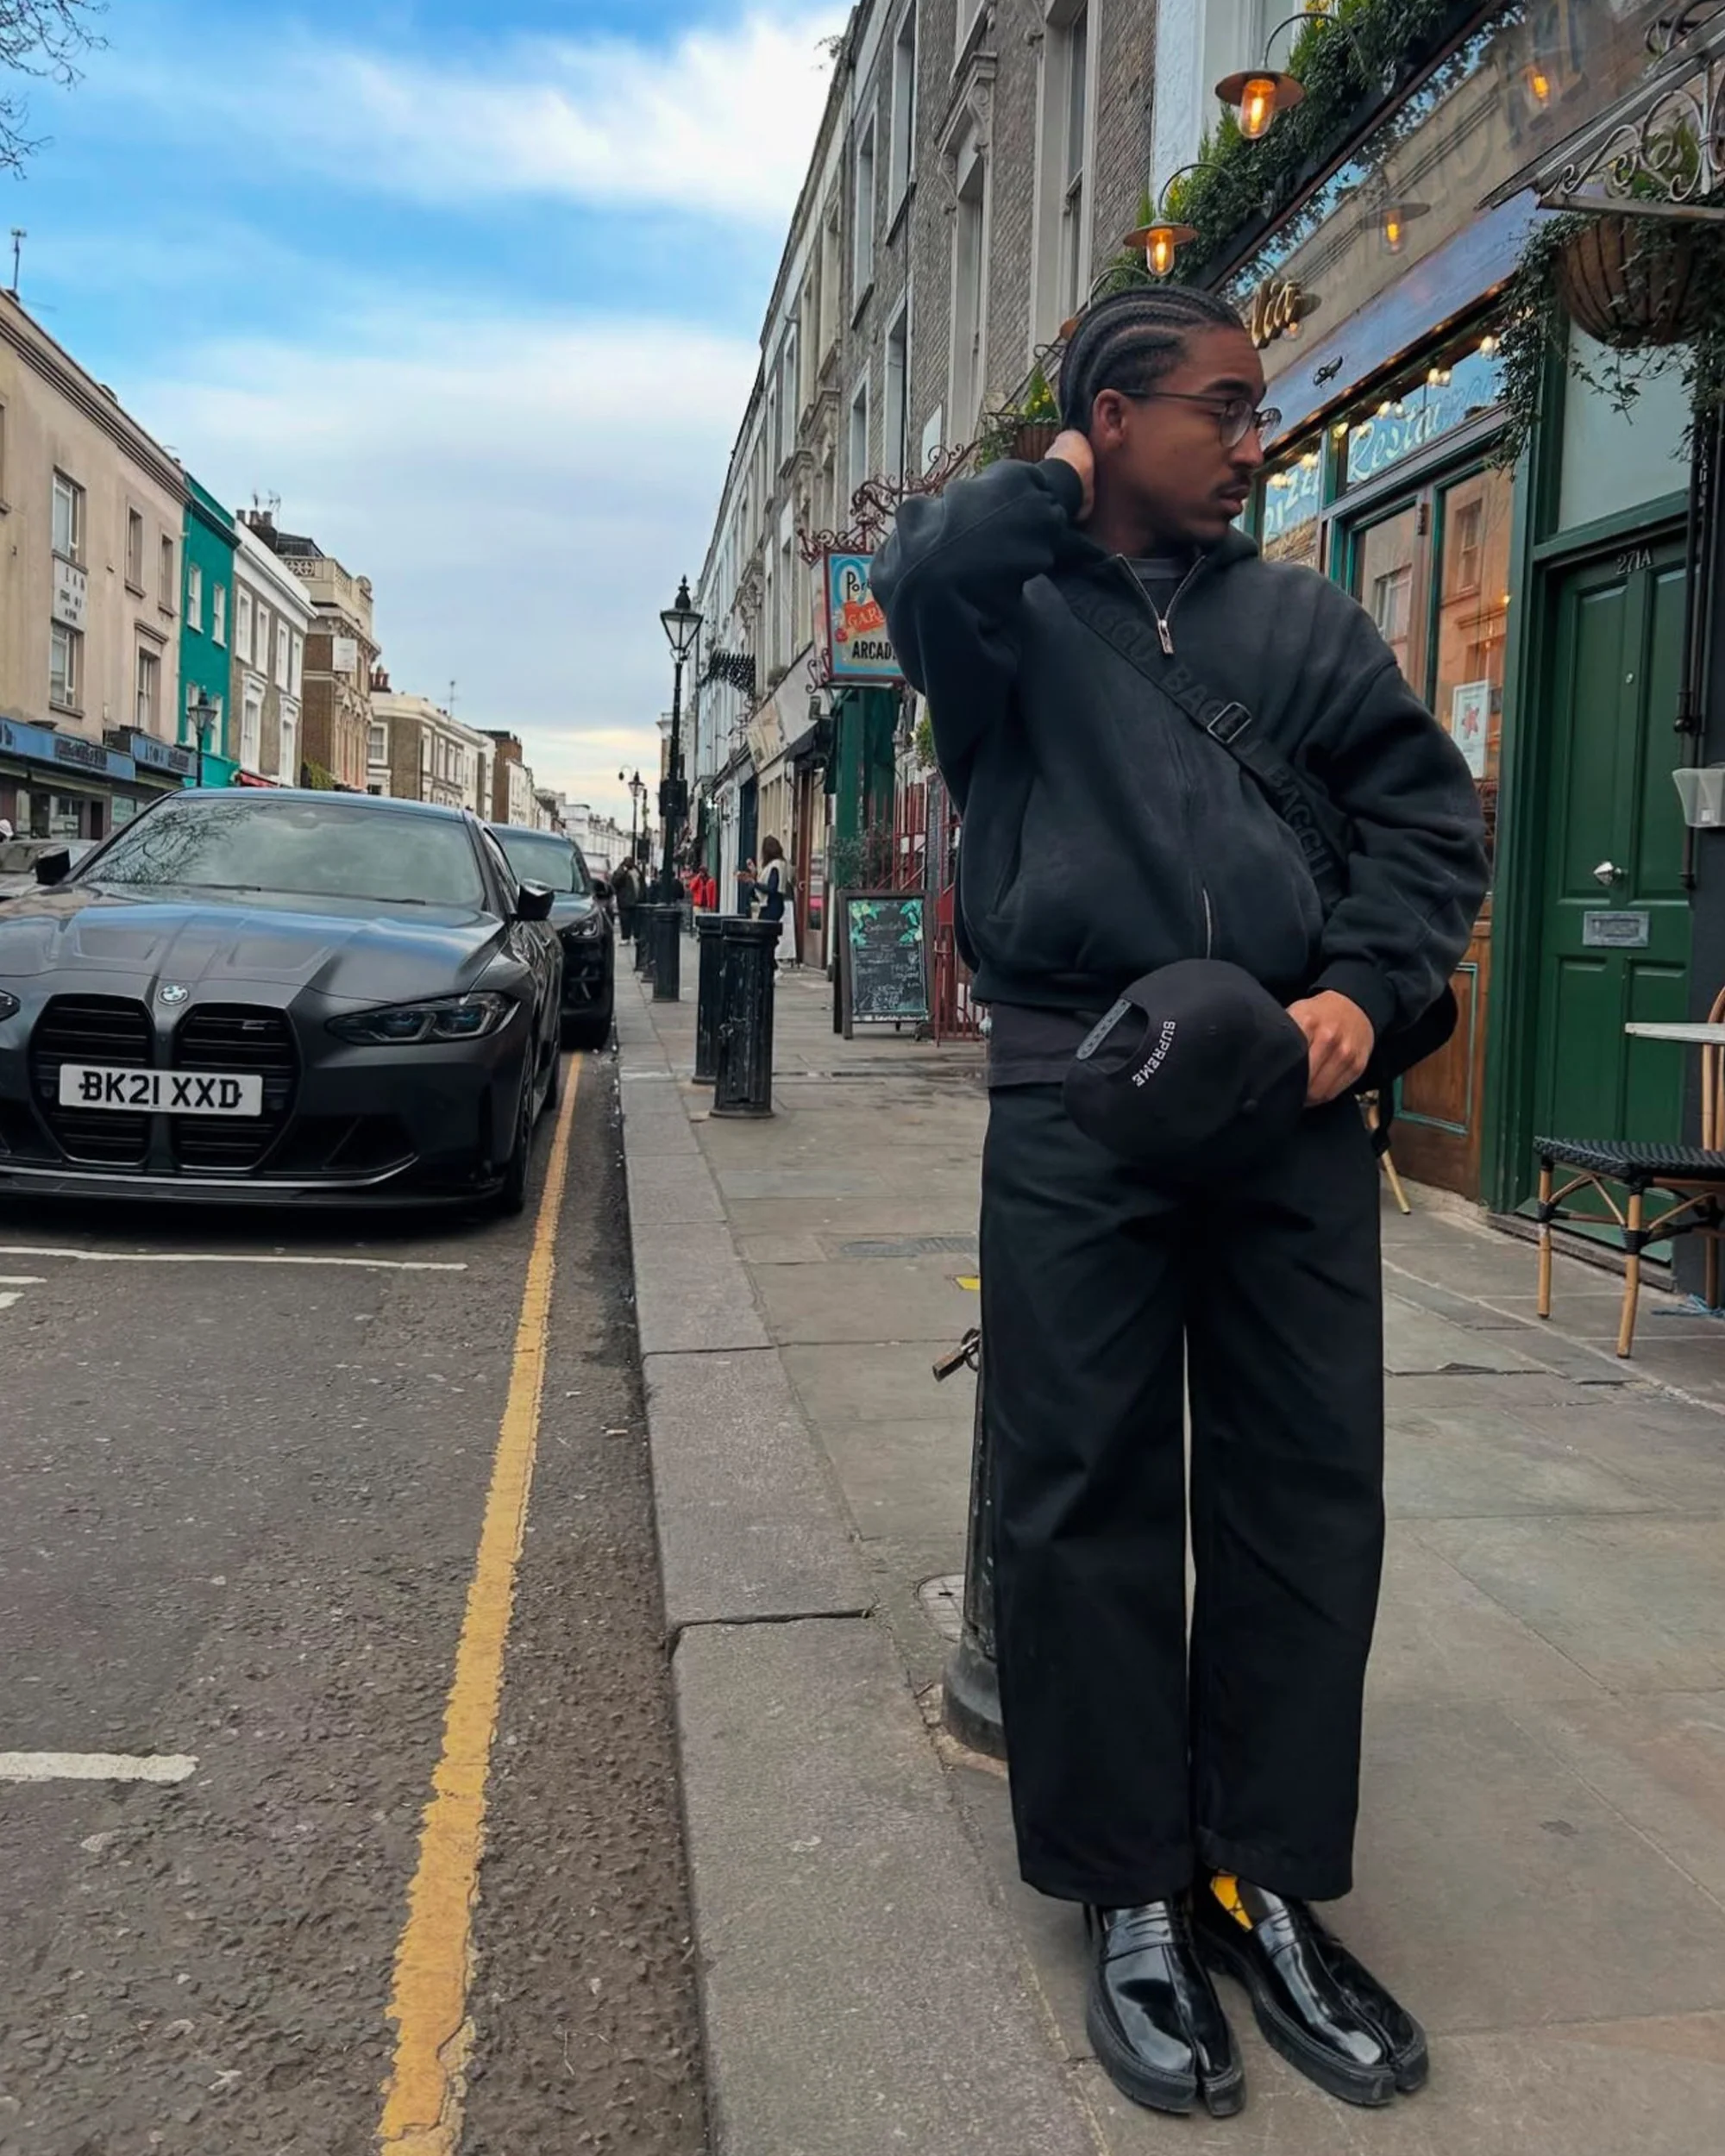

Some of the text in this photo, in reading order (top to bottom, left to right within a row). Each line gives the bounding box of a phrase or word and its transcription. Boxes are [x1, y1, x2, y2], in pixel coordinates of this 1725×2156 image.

[1615, 548, 1652, 574] 271A
[1067, 590, 1157, 661] AGGU
[851, 640, 896, 661] ARCAD
[1132, 1020, 1176, 1087] SUPREME
[80, 1070, 239, 1108] BK21 XXD
